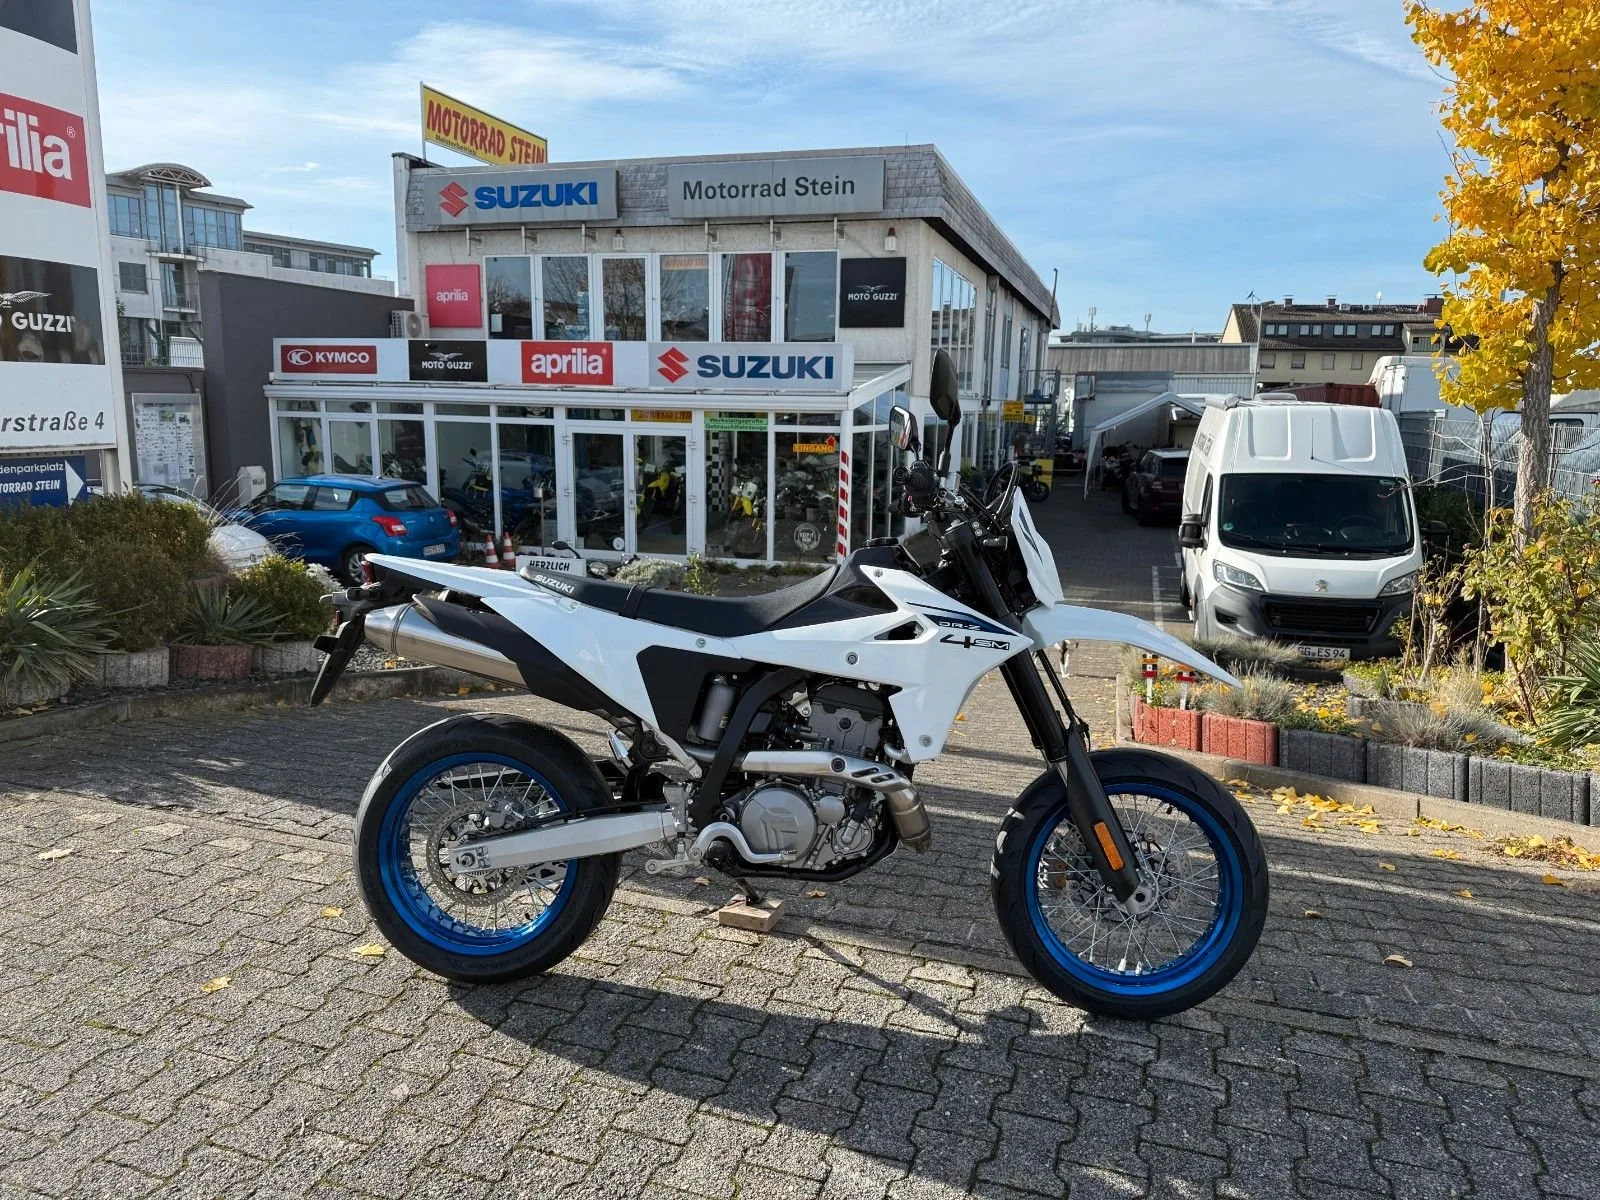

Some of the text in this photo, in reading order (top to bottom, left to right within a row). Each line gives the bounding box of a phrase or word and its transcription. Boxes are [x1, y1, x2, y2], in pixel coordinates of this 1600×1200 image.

[427, 99, 545, 164] MOTORRAD STEIN
[0, 108, 73, 181] ilia
[474, 181, 598, 210] SUZUKI
[683, 175, 855, 200] Motorrad Stein
[436, 288, 468, 303] aprilia
[847, 292, 897, 301] MOTO GUZZI
[11, 311, 72, 333] GUZZI
[315, 351, 370, 364] KYMCO
[421, 360, 472, 370] MOTO GUZZI
[530, 347, 604, 379] aprilia
[696, 354, 834, 380] SUZUKI
[94, 411, 105, 430] 4
[794, 444, 834, 453] EINGANG
[34, 479, 61, 491] STEIN
[528, 559, 571, 572] HERZLICH
[534, 574, 575, 594] SUZUKI
[938, 621, 981, 631] DR-Z
[1317, 647, 1331, 658] ES
[1332, 648, 1346, 659] 94
